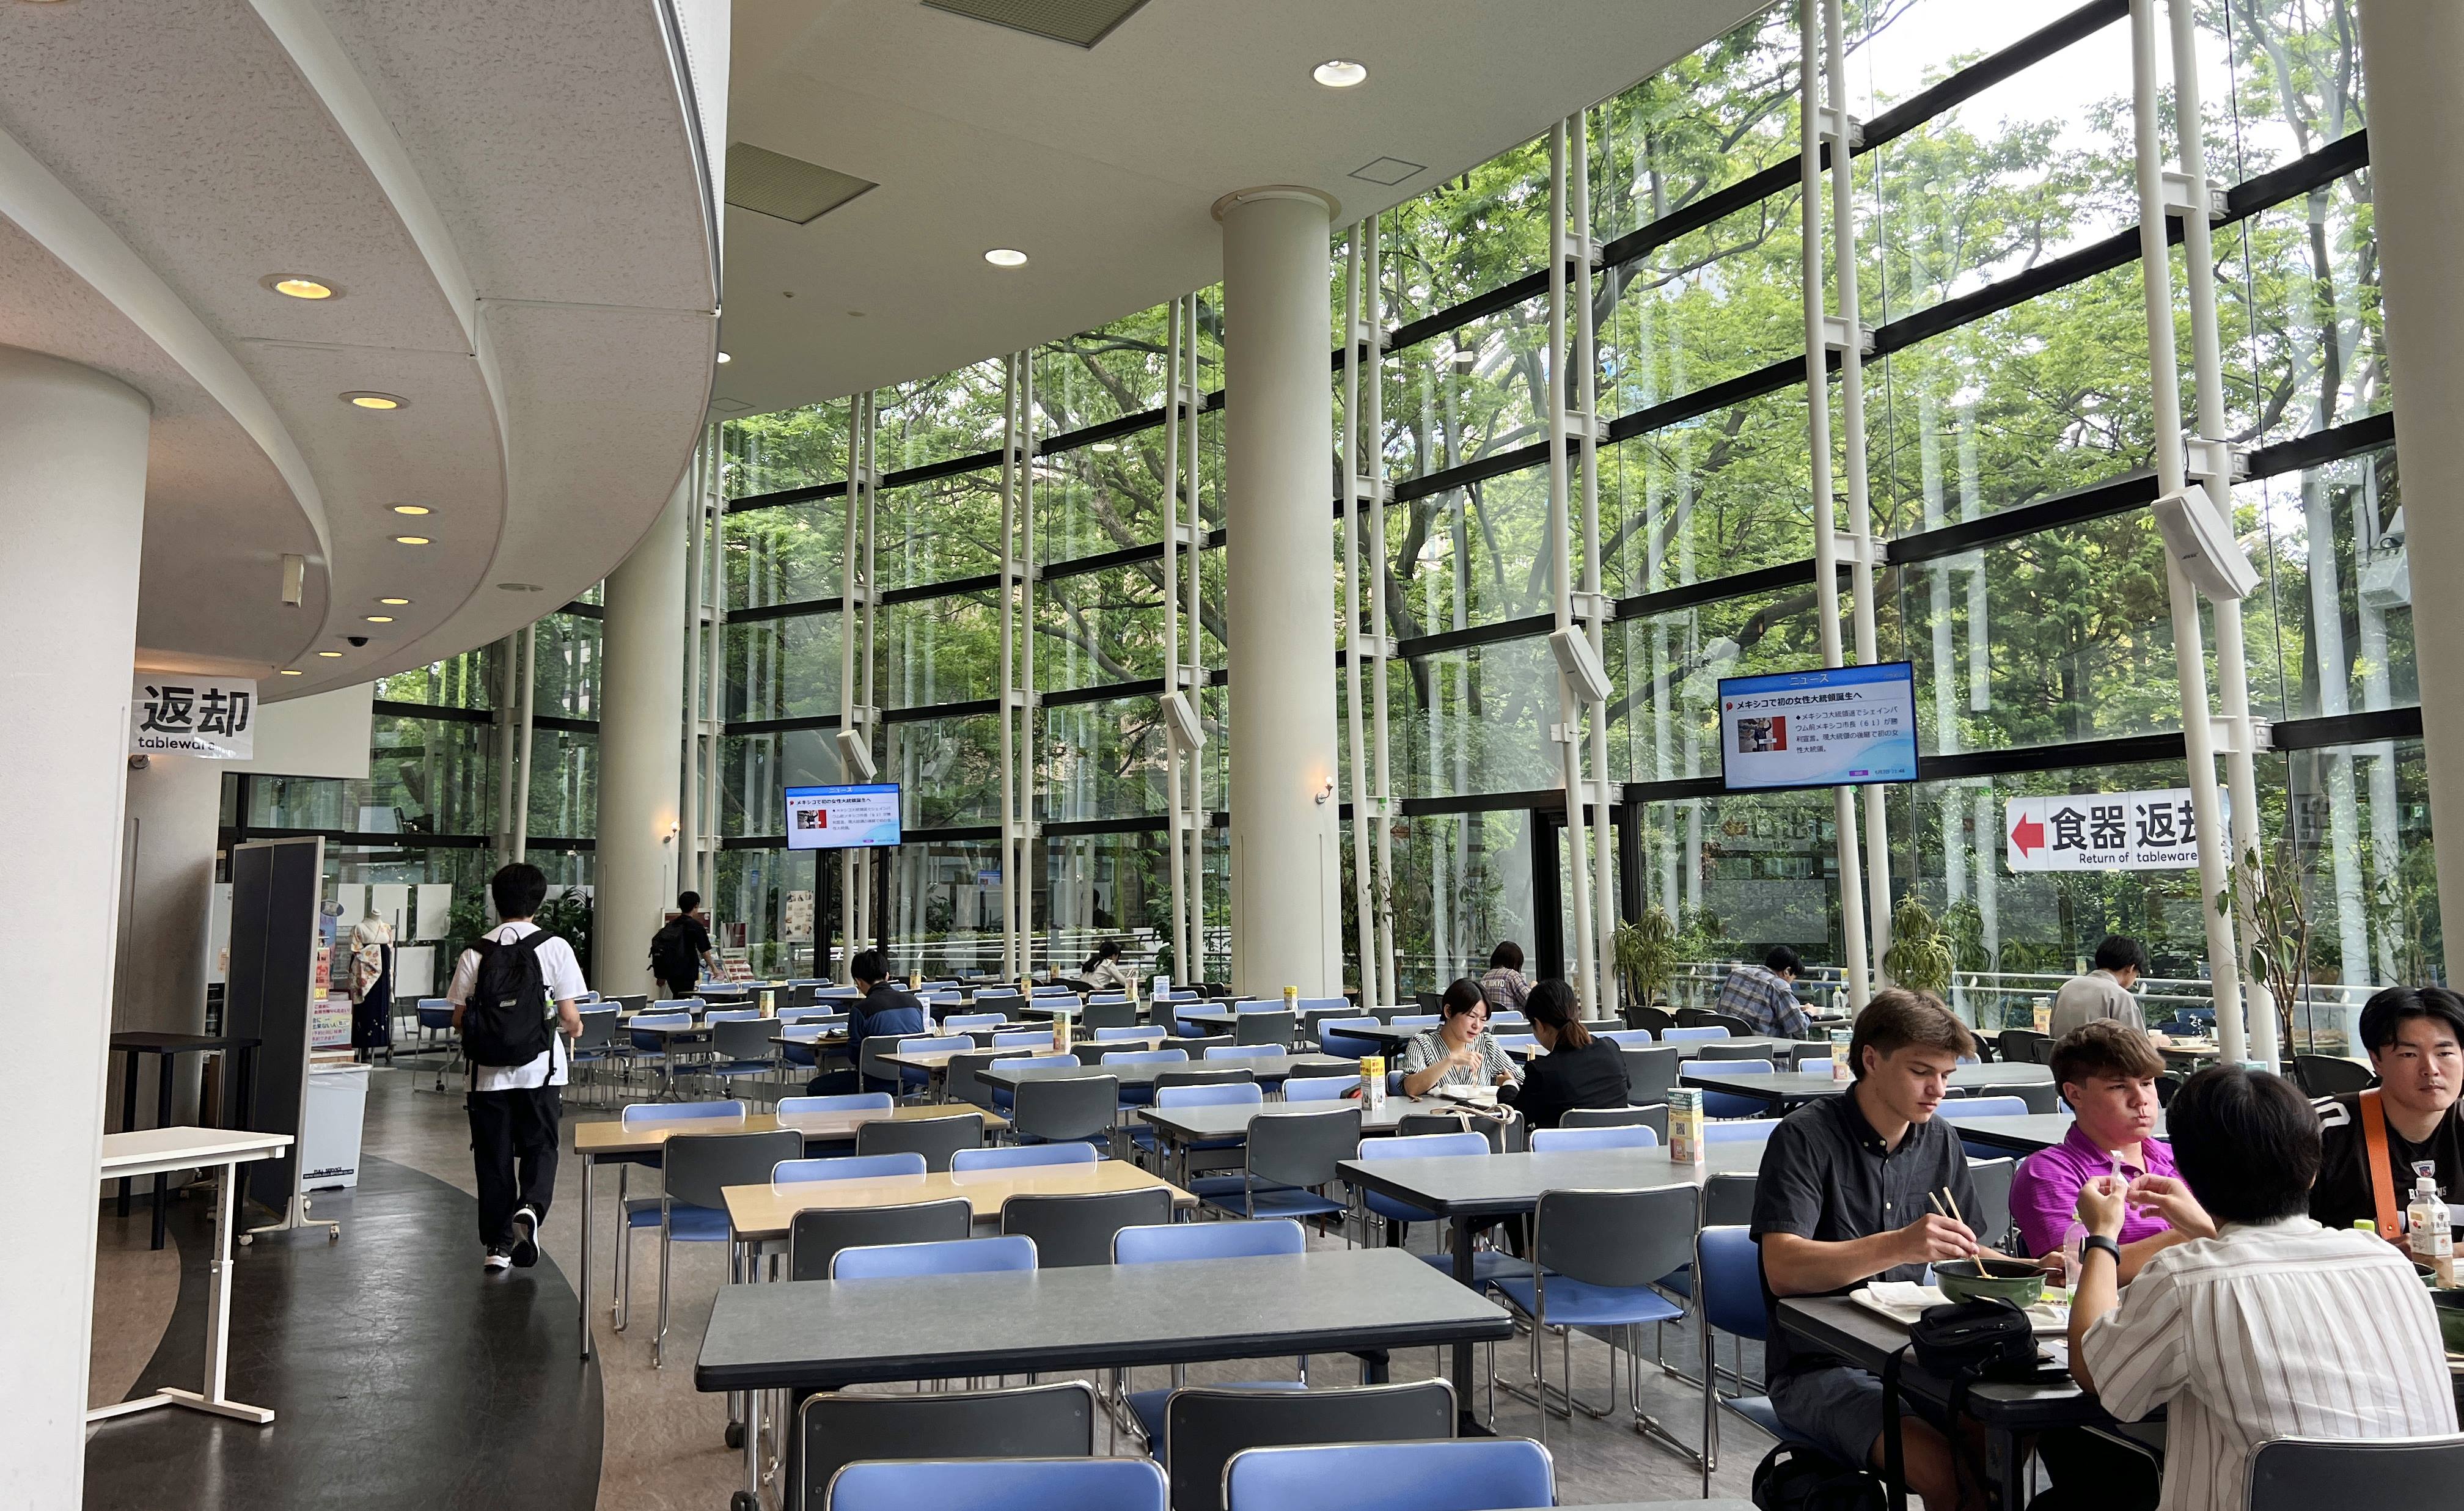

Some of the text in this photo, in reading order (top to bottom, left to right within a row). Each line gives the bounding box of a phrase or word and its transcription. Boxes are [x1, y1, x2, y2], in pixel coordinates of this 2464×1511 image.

[1789, 673, 1829, 686] ニュース
[1737, 692, 1863, 710] メキシコで初の女性大統領誕生へ
[140, 686, 249, 737] 返却
[2080, 851, 2198, 864] Return of tableware
